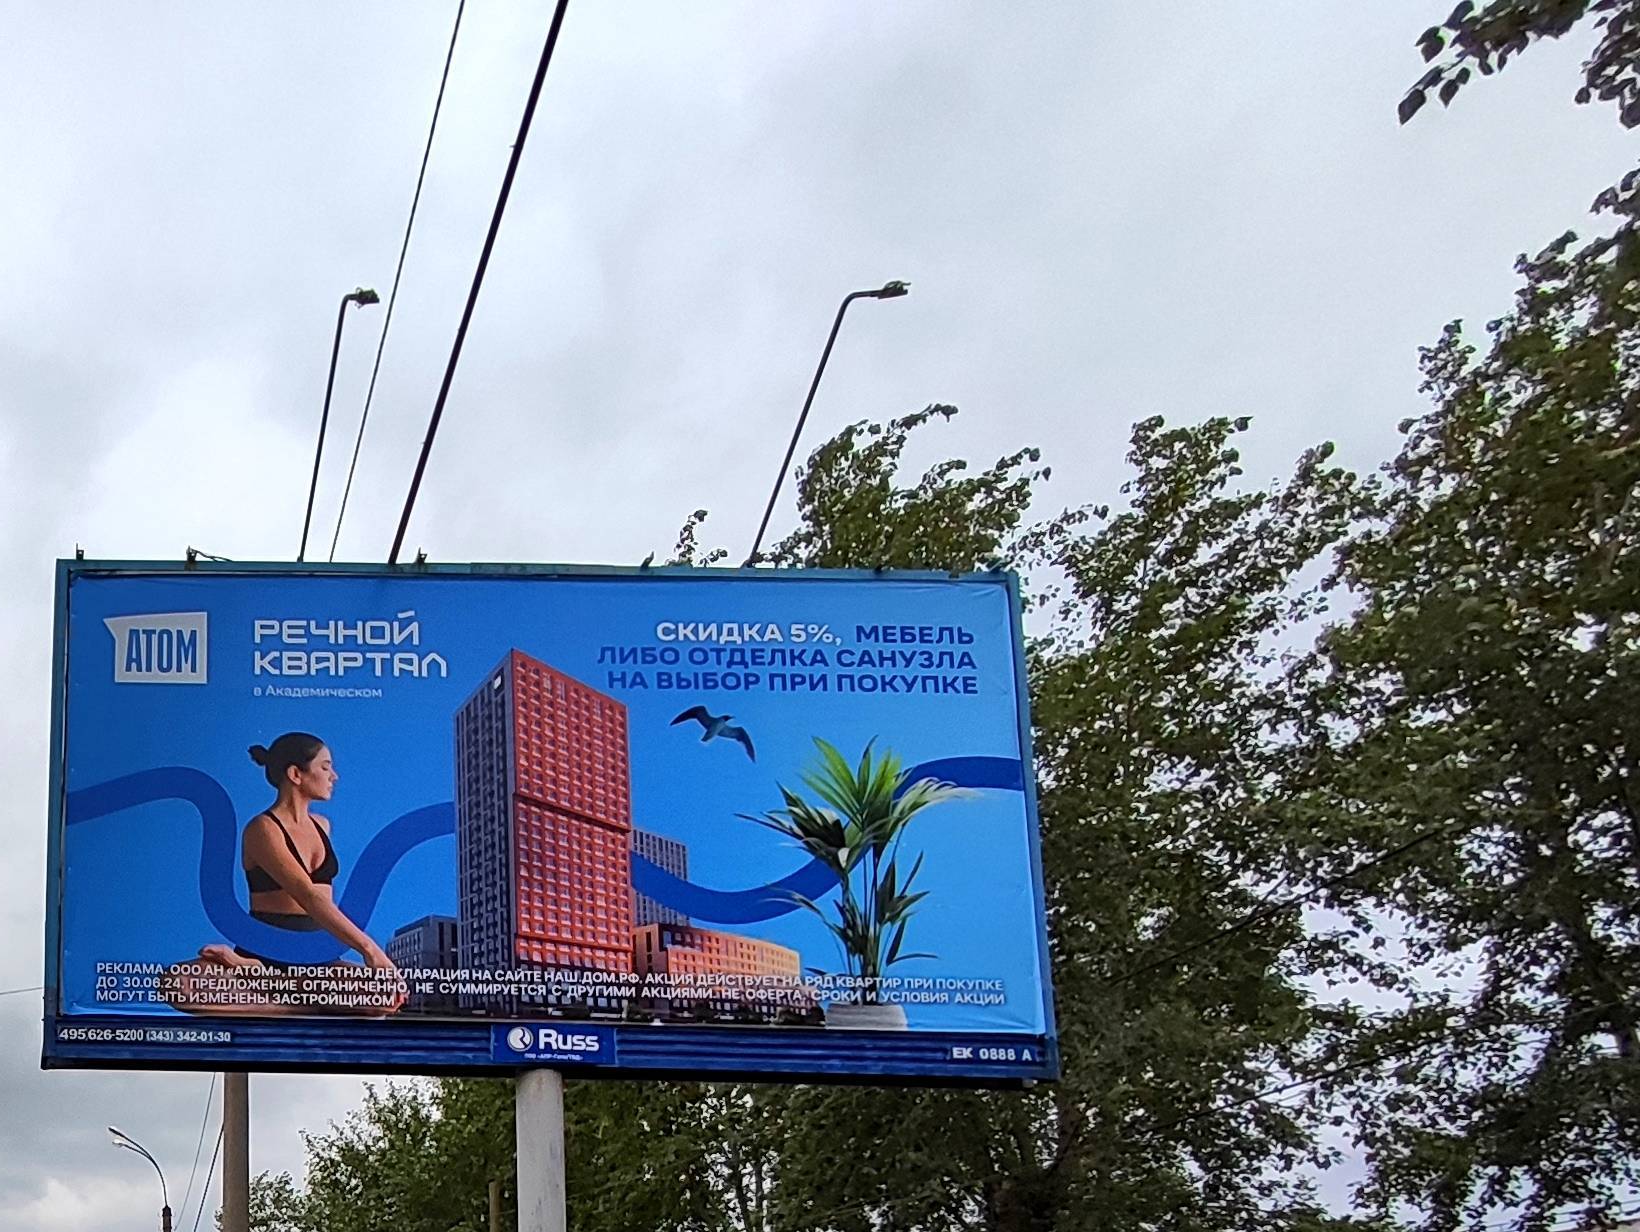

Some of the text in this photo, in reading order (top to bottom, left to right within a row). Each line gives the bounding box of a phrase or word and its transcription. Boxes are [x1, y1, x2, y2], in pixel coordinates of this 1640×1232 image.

[254, 610, 420, 646] РЕЧНОЙ
[655, 622, 974, 647] СКИДКА 5%, МЕБЕЛЬ
[124, 629, 198, 674] АТОМ
[597, 646, 977, 670] ЛИБО ОТДЕЛКА САНУЗЛА
[254, 651, 447, 678] КВАРТАЛ
[254, 685, 383, 699] в Академическом
[607, 671, 979, 695] НА ВЫБОР ПРИ ПОКУПКЕ
[96, 963, 1003, 991] РЕКЛАМА. ООО АН «АТОМ». ПРОЕКТНАЯ ДЕКЛАРАЦИЯ НА САЙТЕ НАШ.ДОМ.РФ. АКЦИЯ ДЕЙСТВУЕТ НА РЯД КВАРТИР ПРИ ПОКУПКЕ
[96, 976, 117, 989] ДО
[122, 977, 184, 989] 30.06.24.
[190, 978, 297, 991] ПРЕДЛОЖЕНИЕ
[302, 980, 410, 994] ОГРАНИЧЕННО,
[416, 982, 434, 993] НЕ
[439, 983, 546, 996] СУММИРУЕТСЯ
[551, 985, 562, 996] С
[567, 985, 636, 998] ДРУГИМИ
[722, 988, 740, 1000] НЕ
[745, 989, 806, 1001] ОФЕРТА.
[810, 990, 861, 1002] СРОКИ
[866, 991, 876, 1002] И
[882, 991, 948, 1003] УСЛОВИЯ
[954, 993, 1005, 1006] АКЦИИ
[96, 990, 145, 1002] МОГУТ
[147, 991, 187, 1002] БЫТЬ
[189, 992, 269, 1004] ИЗМЕНЕНЫ
[145, 1031, 174, 1042] (343)
[176, 1032, 231, 1042] 342-01-30
[538, 1028, 600, 1052] Russ
[979, 1048, 1016, 1061] 0888
